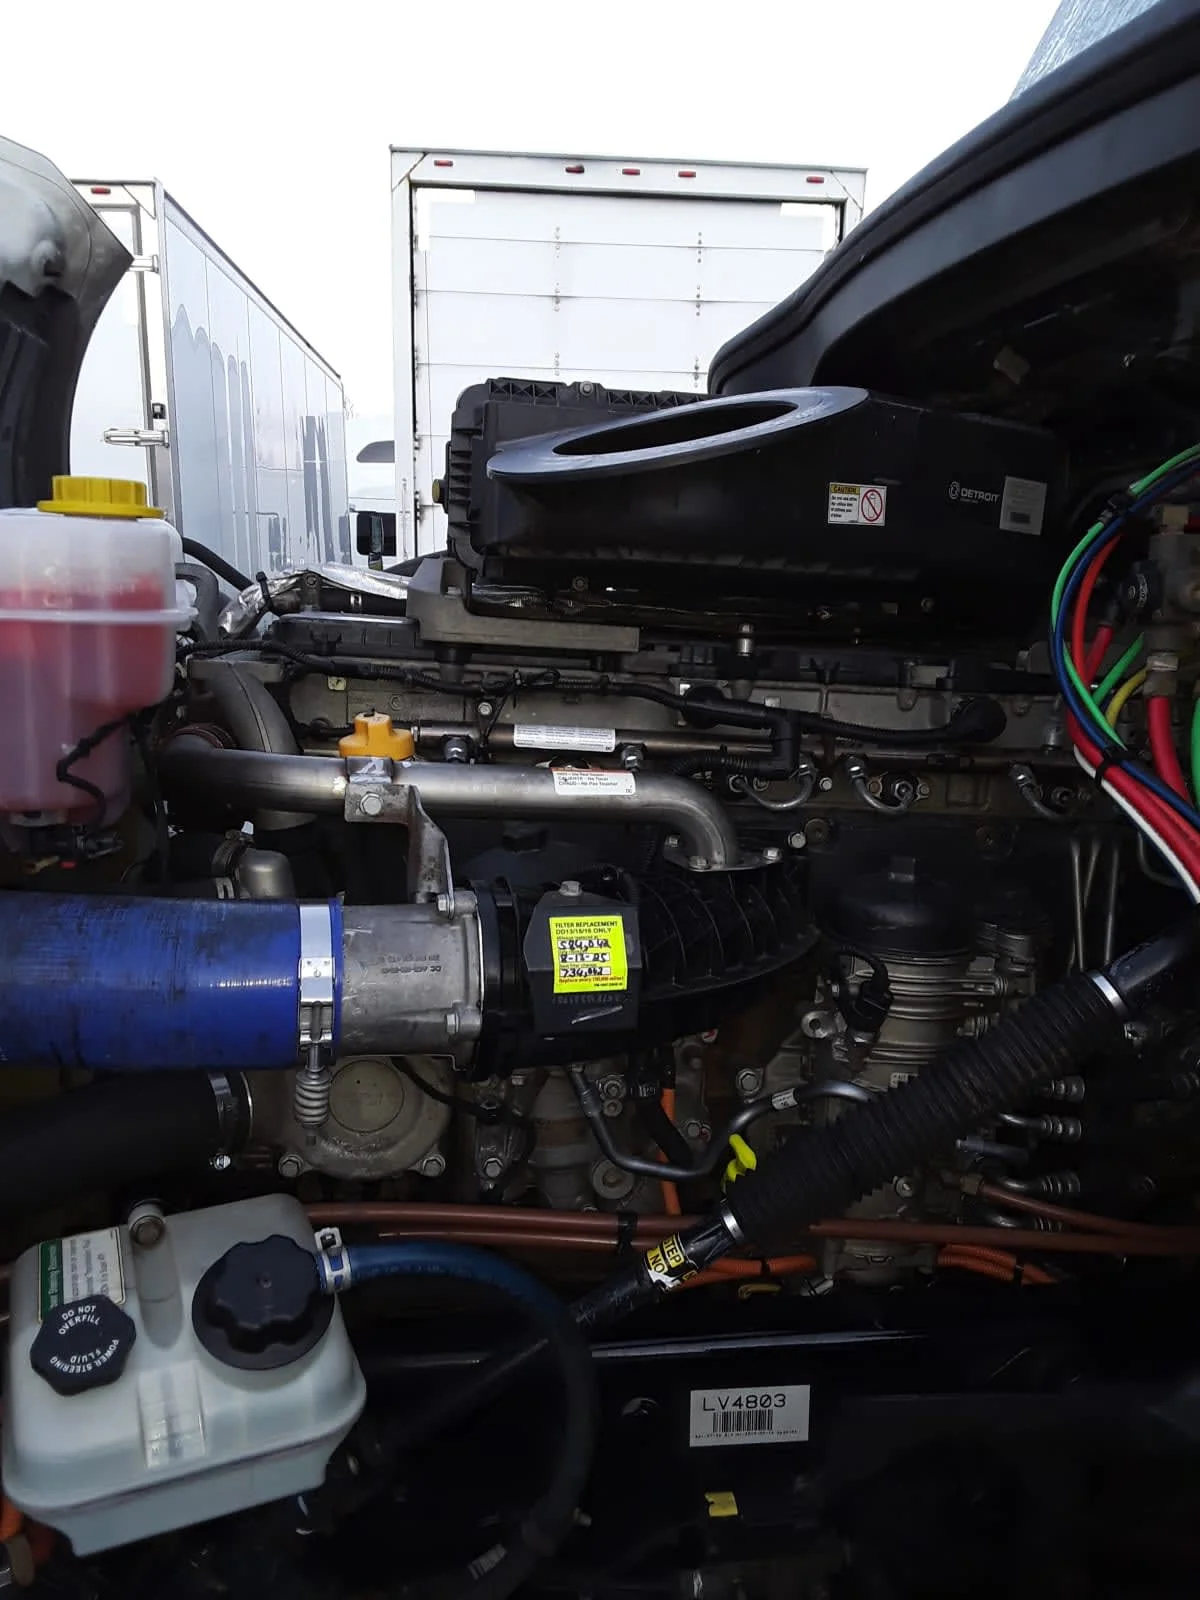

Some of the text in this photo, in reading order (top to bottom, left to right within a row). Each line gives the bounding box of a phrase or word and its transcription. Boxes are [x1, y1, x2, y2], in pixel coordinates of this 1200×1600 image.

[833, 486, 857, 494] CAUTION
[960, 487, 1000, 503] DETROIT
[649, 1254, 665, 1273] NO
[61, 1305, 97, 1321] DO NOT
[58, 1314, 101, 1335] OVERFILL
[49, 1339, 119, 1374] POWER STEERING
[70, 1348, 102, 1364] FLUID
[702, 1393, 786, 1411] LV4803
